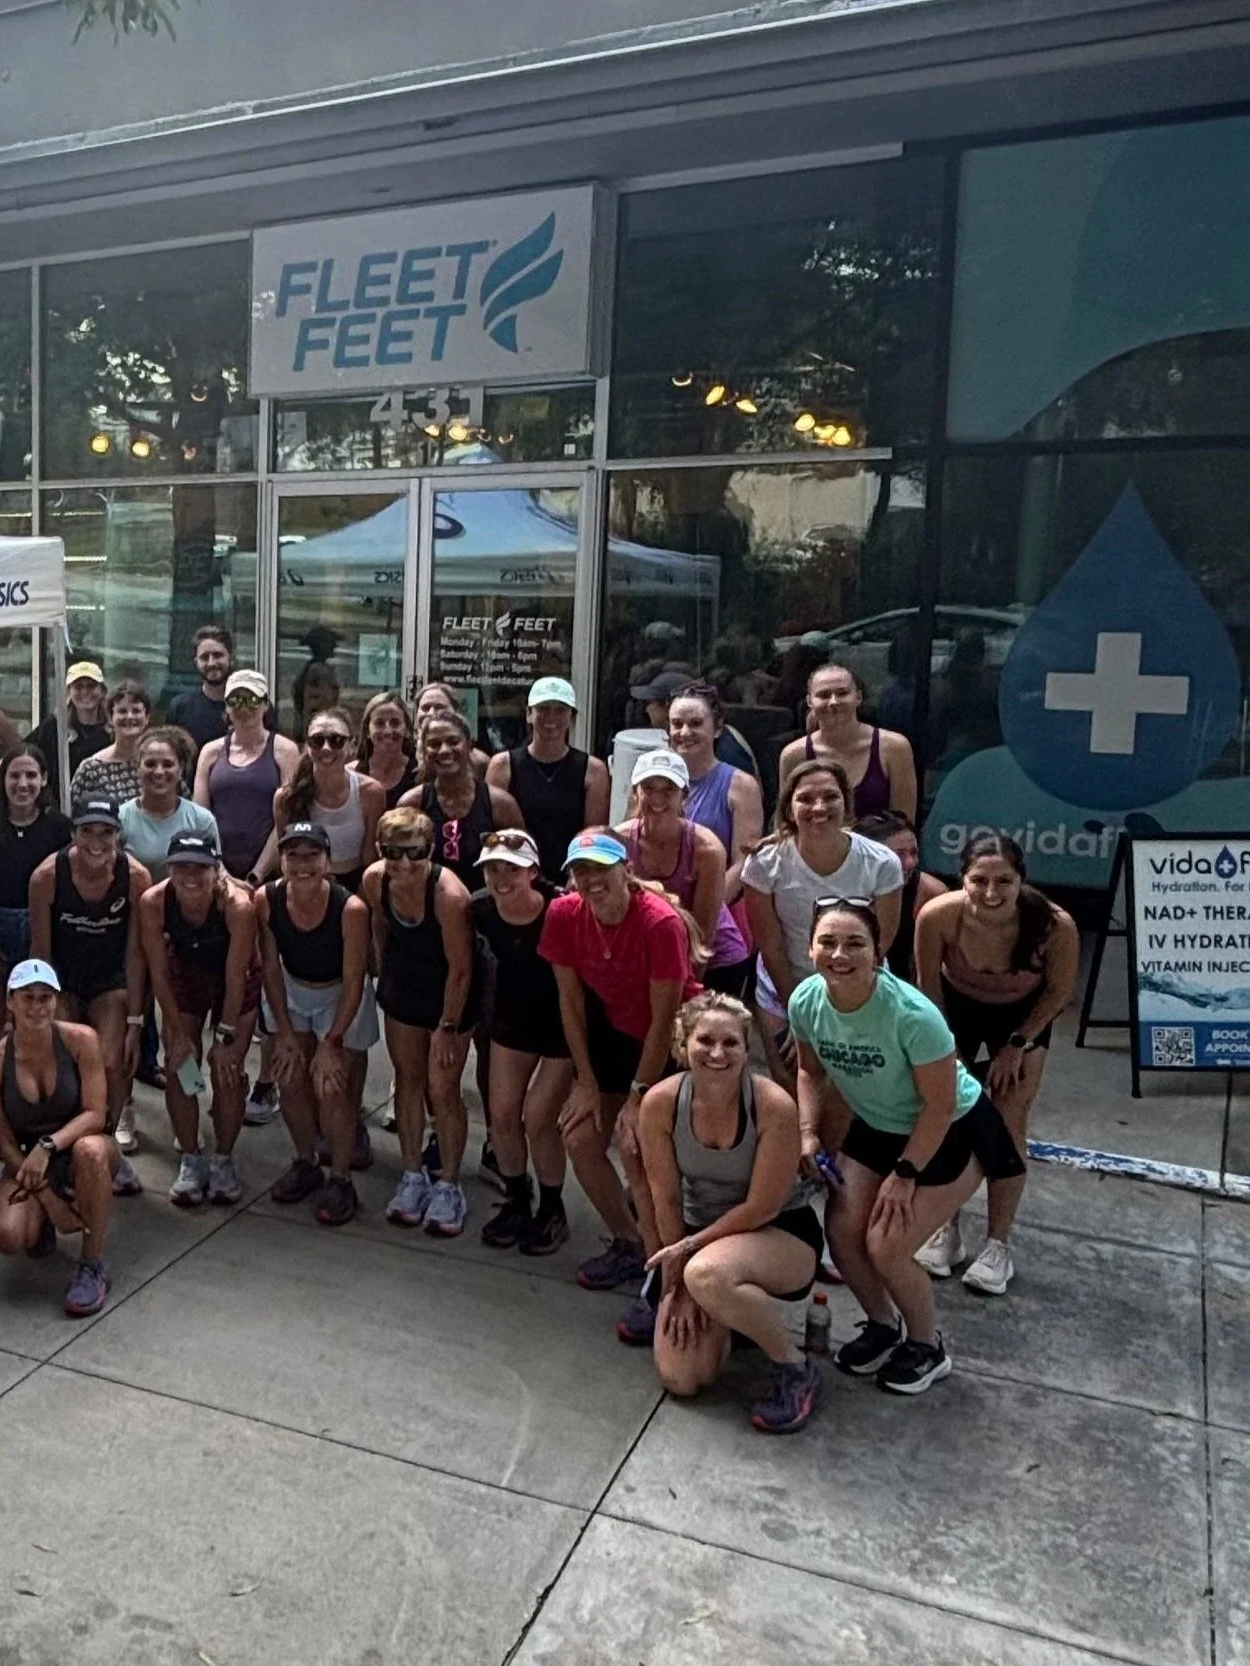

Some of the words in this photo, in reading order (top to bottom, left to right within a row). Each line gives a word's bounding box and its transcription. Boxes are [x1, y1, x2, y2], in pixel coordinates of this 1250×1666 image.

[275, 239, 491, 317] FLEET
[292, 303, 467, 372] FEET
[370, 386, 484, 432] 431
[442, 616, 492, 631] FLEET
[513, 617, 557, 632] FEET
[440, 637, 475, 648] Monday
[482, 638, 510, 649] Friday
[1144, 906, 1198, 921] NAD+
[1149, 934, 1167, 949] IV
[1141, 960, 1202, 973] VITAMIN
